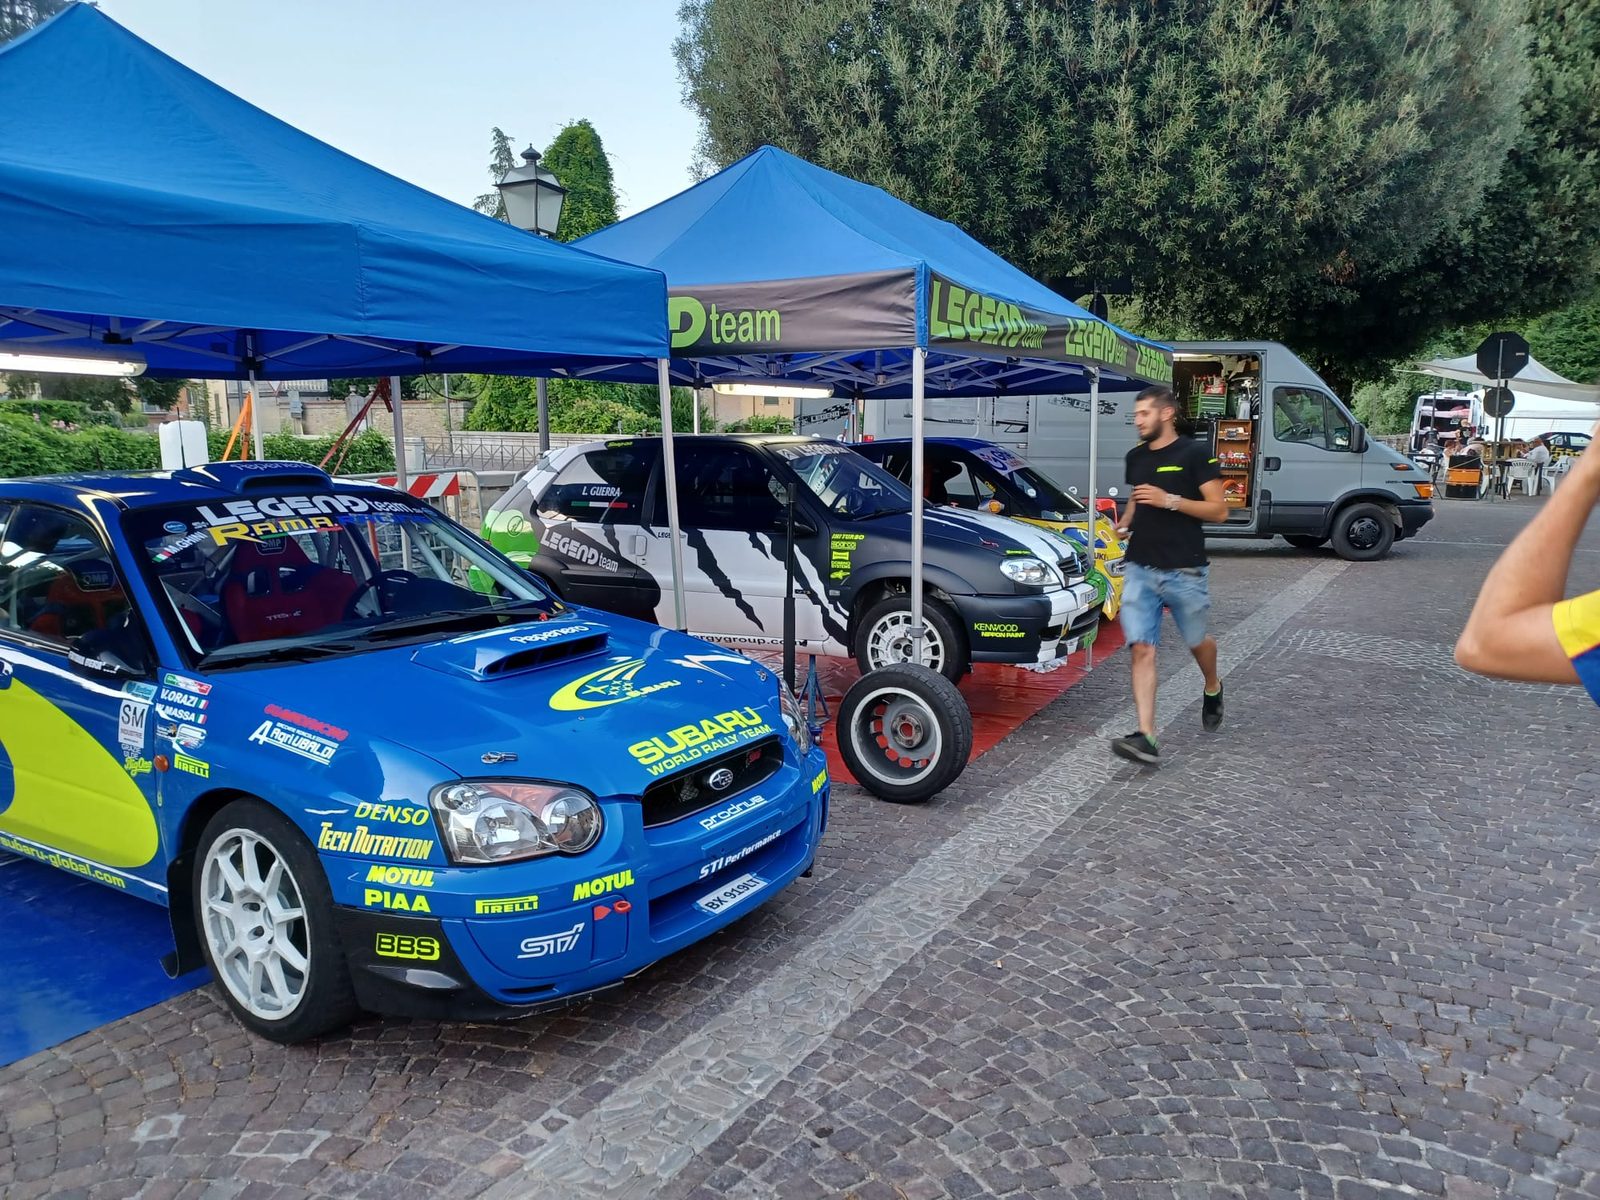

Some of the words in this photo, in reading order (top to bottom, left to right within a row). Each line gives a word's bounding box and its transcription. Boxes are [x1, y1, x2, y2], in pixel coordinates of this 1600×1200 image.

[711, 302, 782, 345] team
[930, 279, 1027, 348] LEGEND
[1021, 314, 1048, 350] team
[1065, 317, 1117, 364] LEGEND
[1135, 342, 1167, 382] LEGEND
[590, 485, 621, 497] GUERRA
[196, 494, 369, 527] LEGEND
[363, 497, 414, 513] team
[540, 528, 599, 566] LEGEND
[598, 552, 619, 574] team
[509, 625, 590, 644] Pepenero
[973, 623, 1019, 632] KENWOOD
[155, 702, 195, 722] W.MASSA
[160, 688, 199, 707] V.ORAZI
[627, 706, 763, 766] SUBARU
[646, 747, 702, 776] WORLD
[700, 733, 740, 754] RALLY
[741, 724, 773, 740] TEAM
[173, 753, 210, 779] PIRELLI
[811, 768, 827, 795] MOTUL
[353, 801, 430, 827] DENSO
[0, 836, 126, 889] subaru-global.com
[698, 856, 724, 880] STI
[724, 829, 782, 867] Performance
[365, 864, 436, 888] MOTUL
[571, 868, 636, 902] MOTUL
[364, 888, 432, 914] PIAA
[475, 895, 539, 915] PIRELLI
[704, 894, 729, 911] BX
[724, 878, 760, 900] 919LT
[375, 932, 440, 961] BBS
[517, 922, 586, 960] STI
